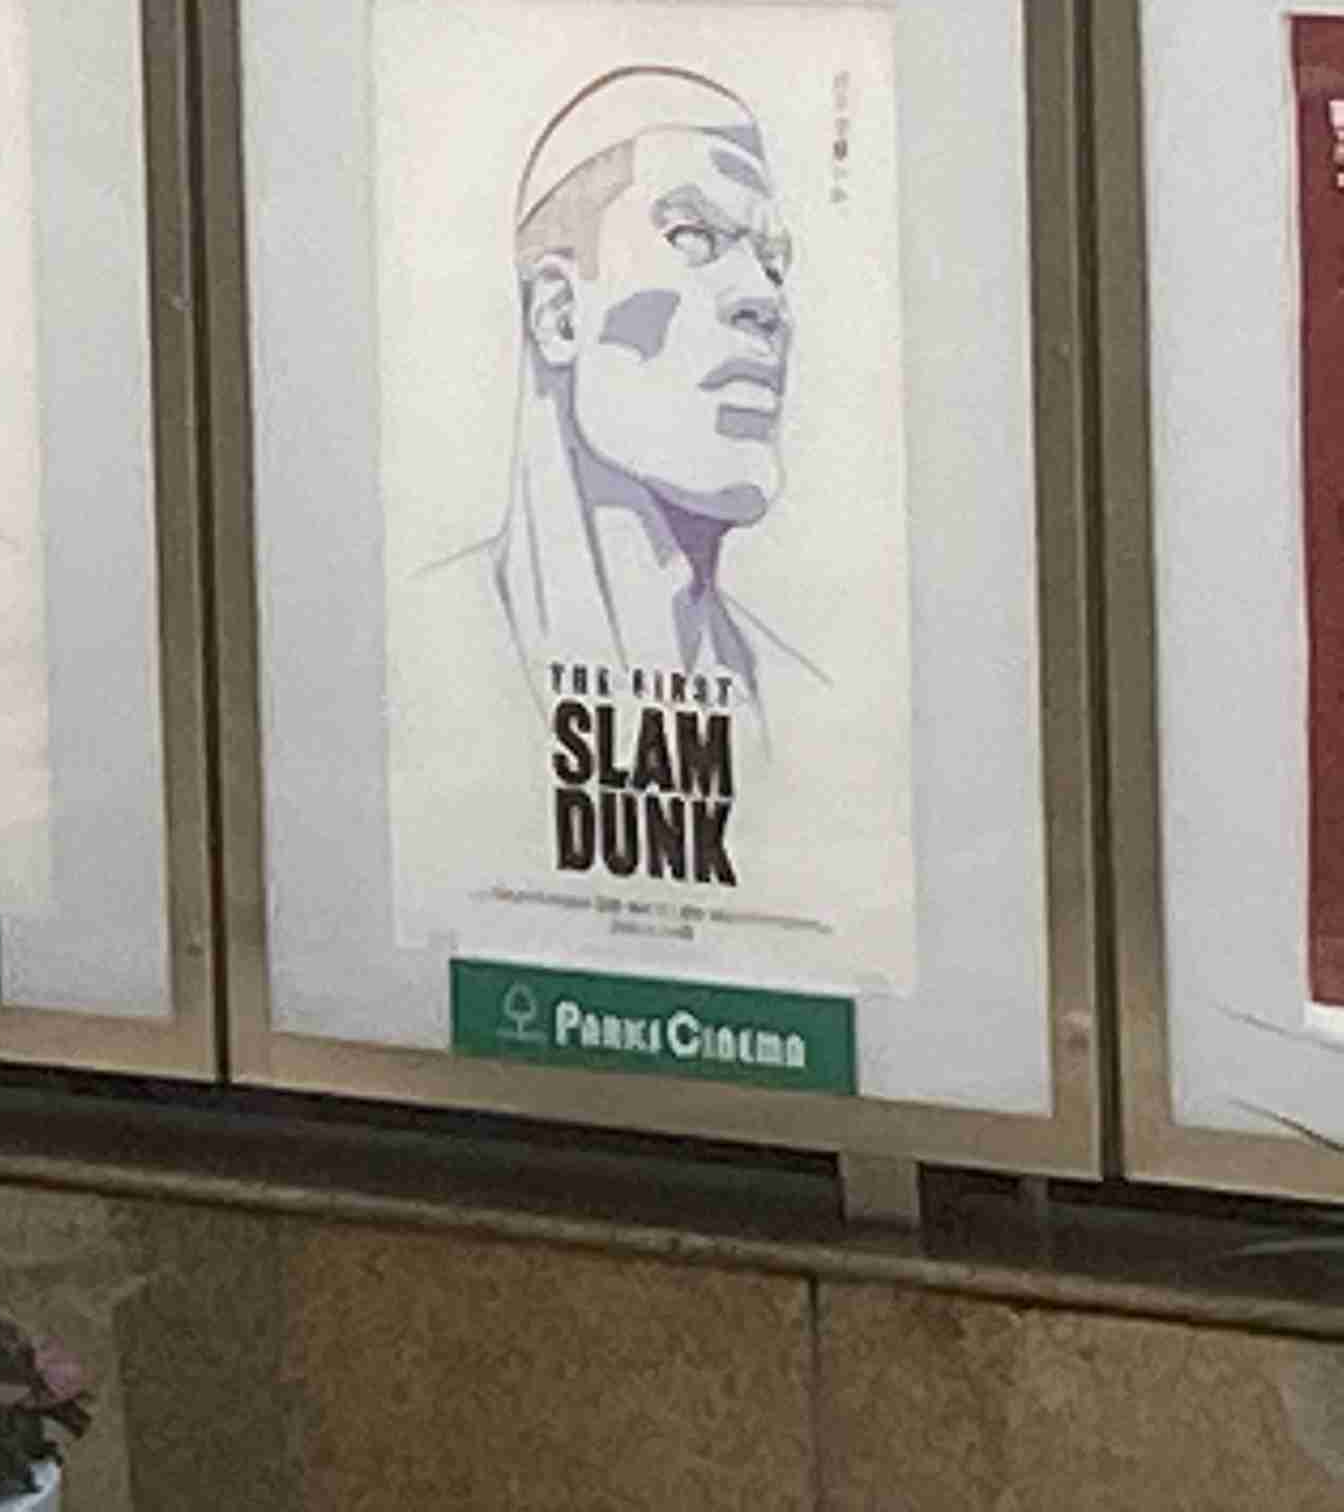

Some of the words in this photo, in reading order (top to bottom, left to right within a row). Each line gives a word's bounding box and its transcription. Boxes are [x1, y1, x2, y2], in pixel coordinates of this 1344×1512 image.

[550, 662, 611, 696] THE
[632, 667, 735, 707] FIRST
[551, 699, 737, 799] SLAM
[554, 787, 739, 889] DUNK
